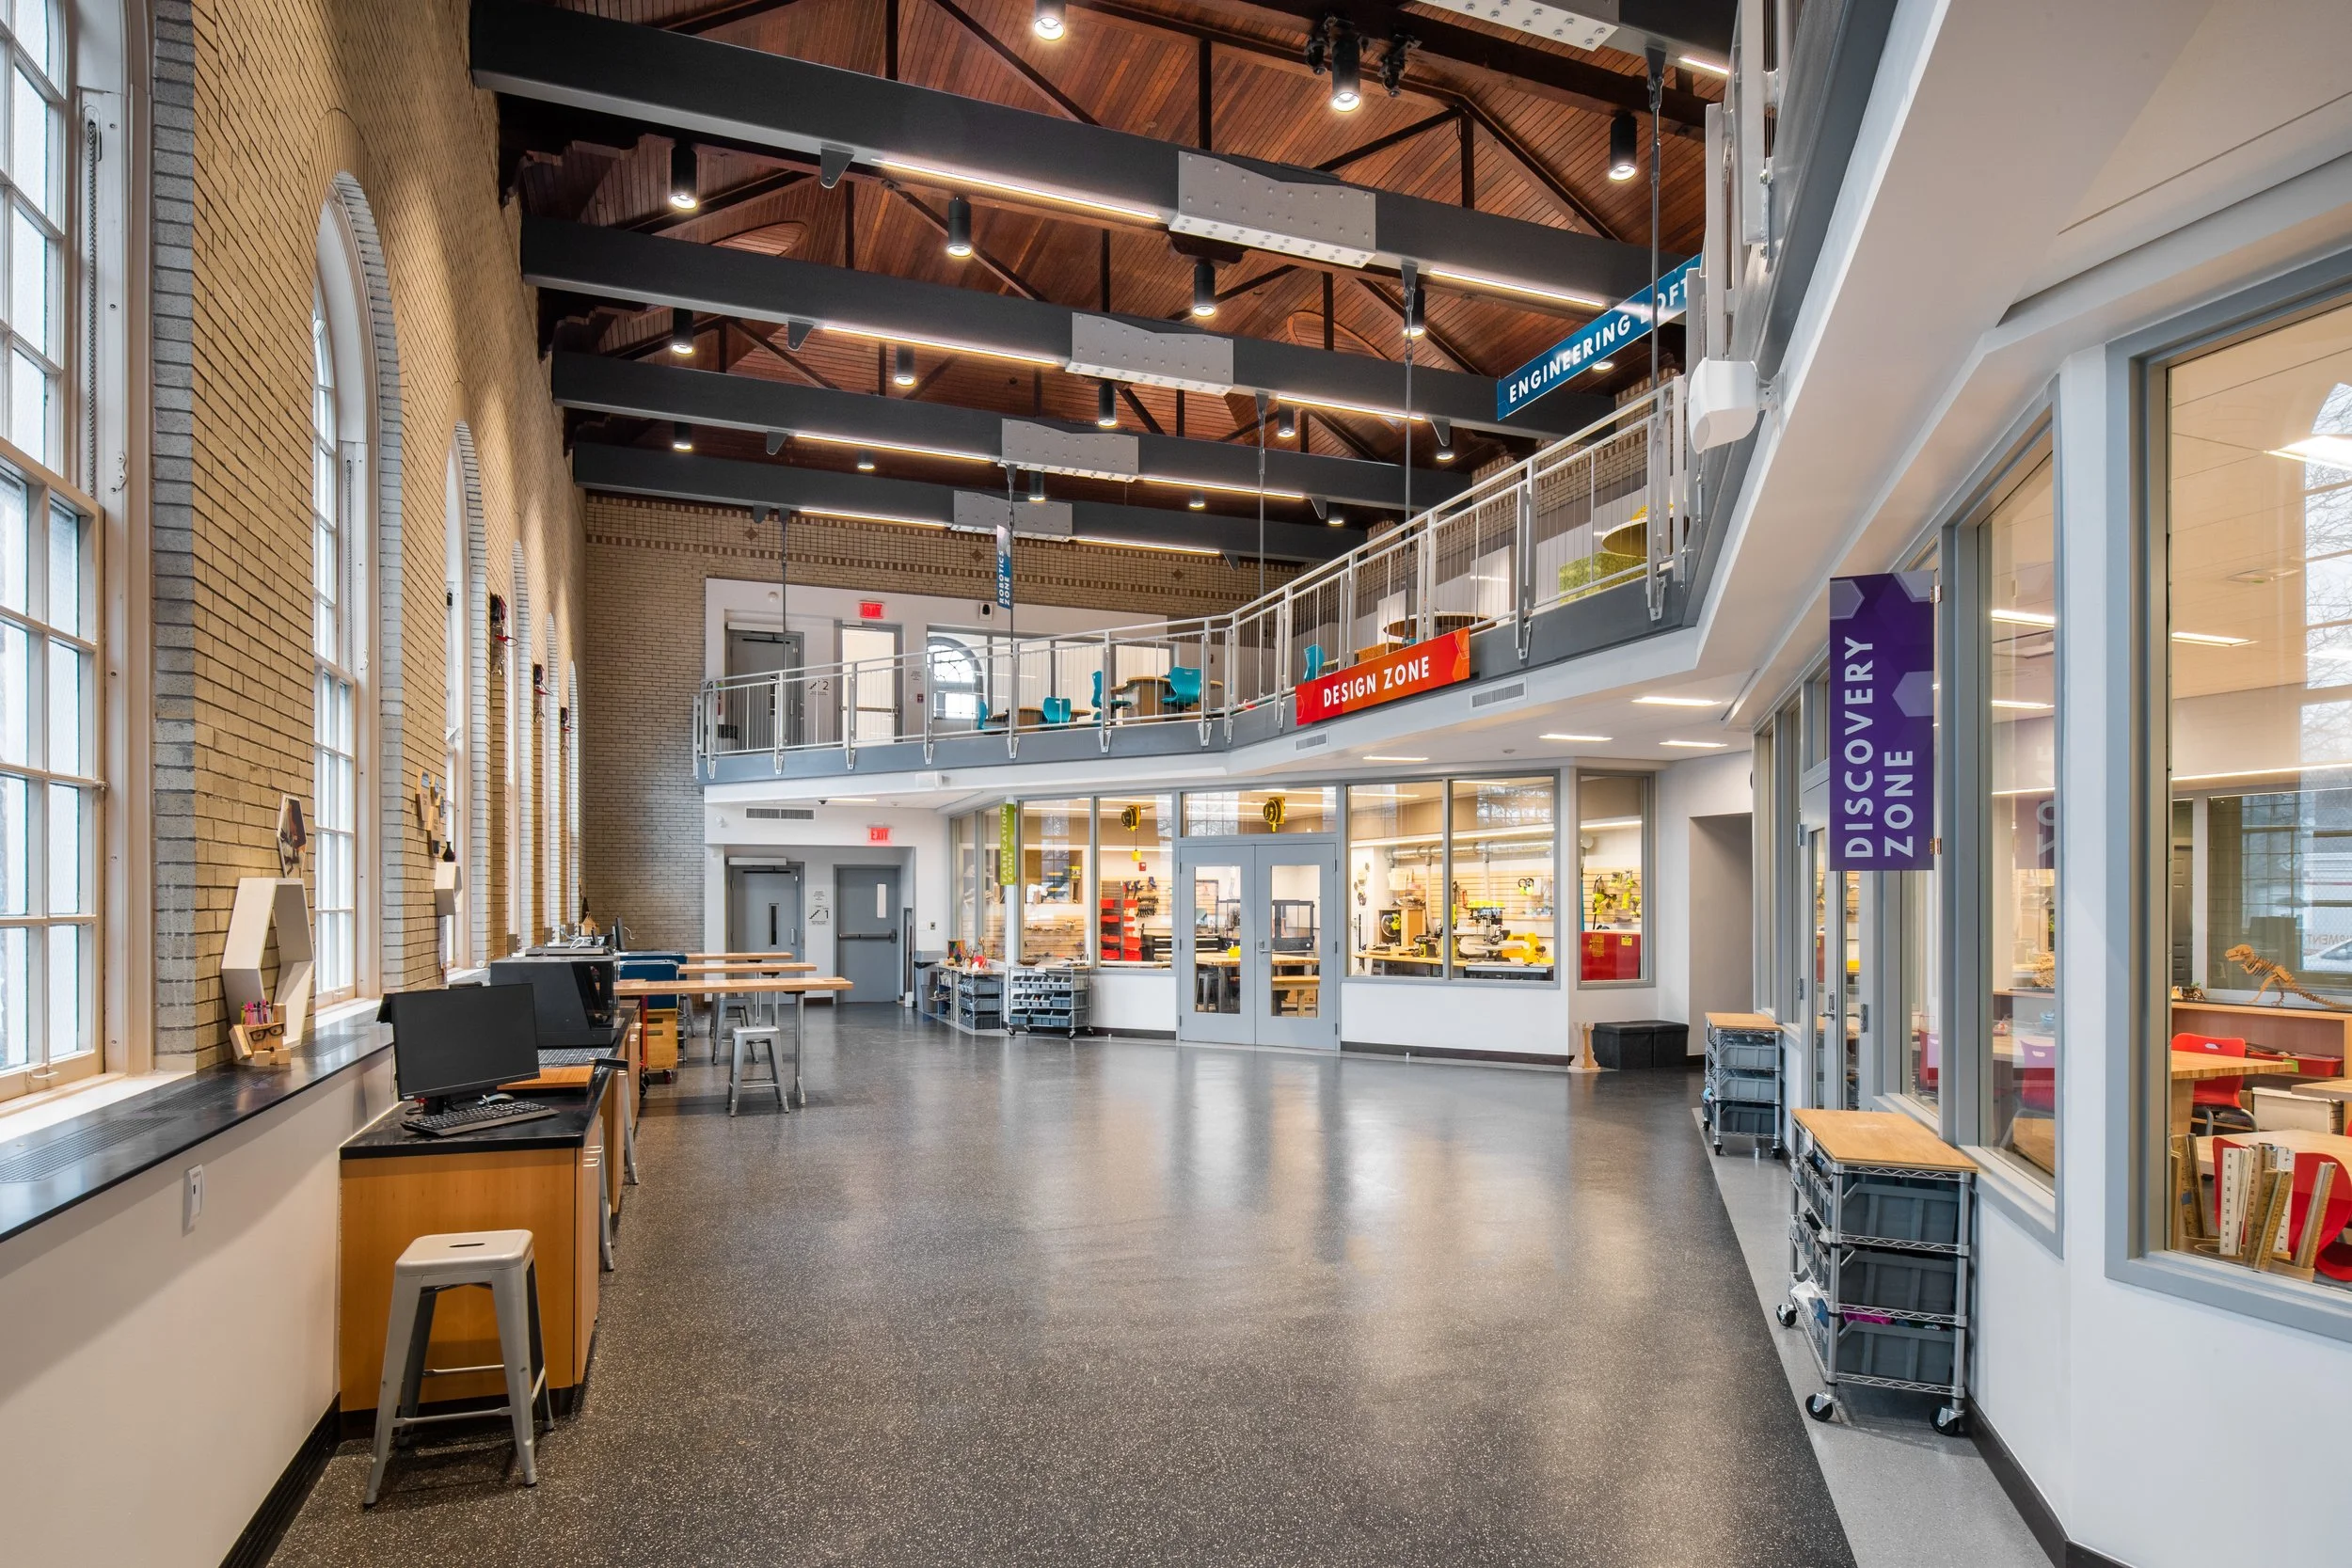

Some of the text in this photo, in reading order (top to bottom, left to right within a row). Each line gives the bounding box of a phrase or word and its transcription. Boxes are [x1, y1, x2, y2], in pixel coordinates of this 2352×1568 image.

[1509, 314, 1631, 404] ENGINEERING
[822, 680, 829, 689] 2
[1324, 656, 1429, 707] DESIGN ZONE
[1844, 636, 1874, 858] DISCOVERY
[870, 827, 889, 841] EXIT
[1883, 751, 1914, 858] ZONE
